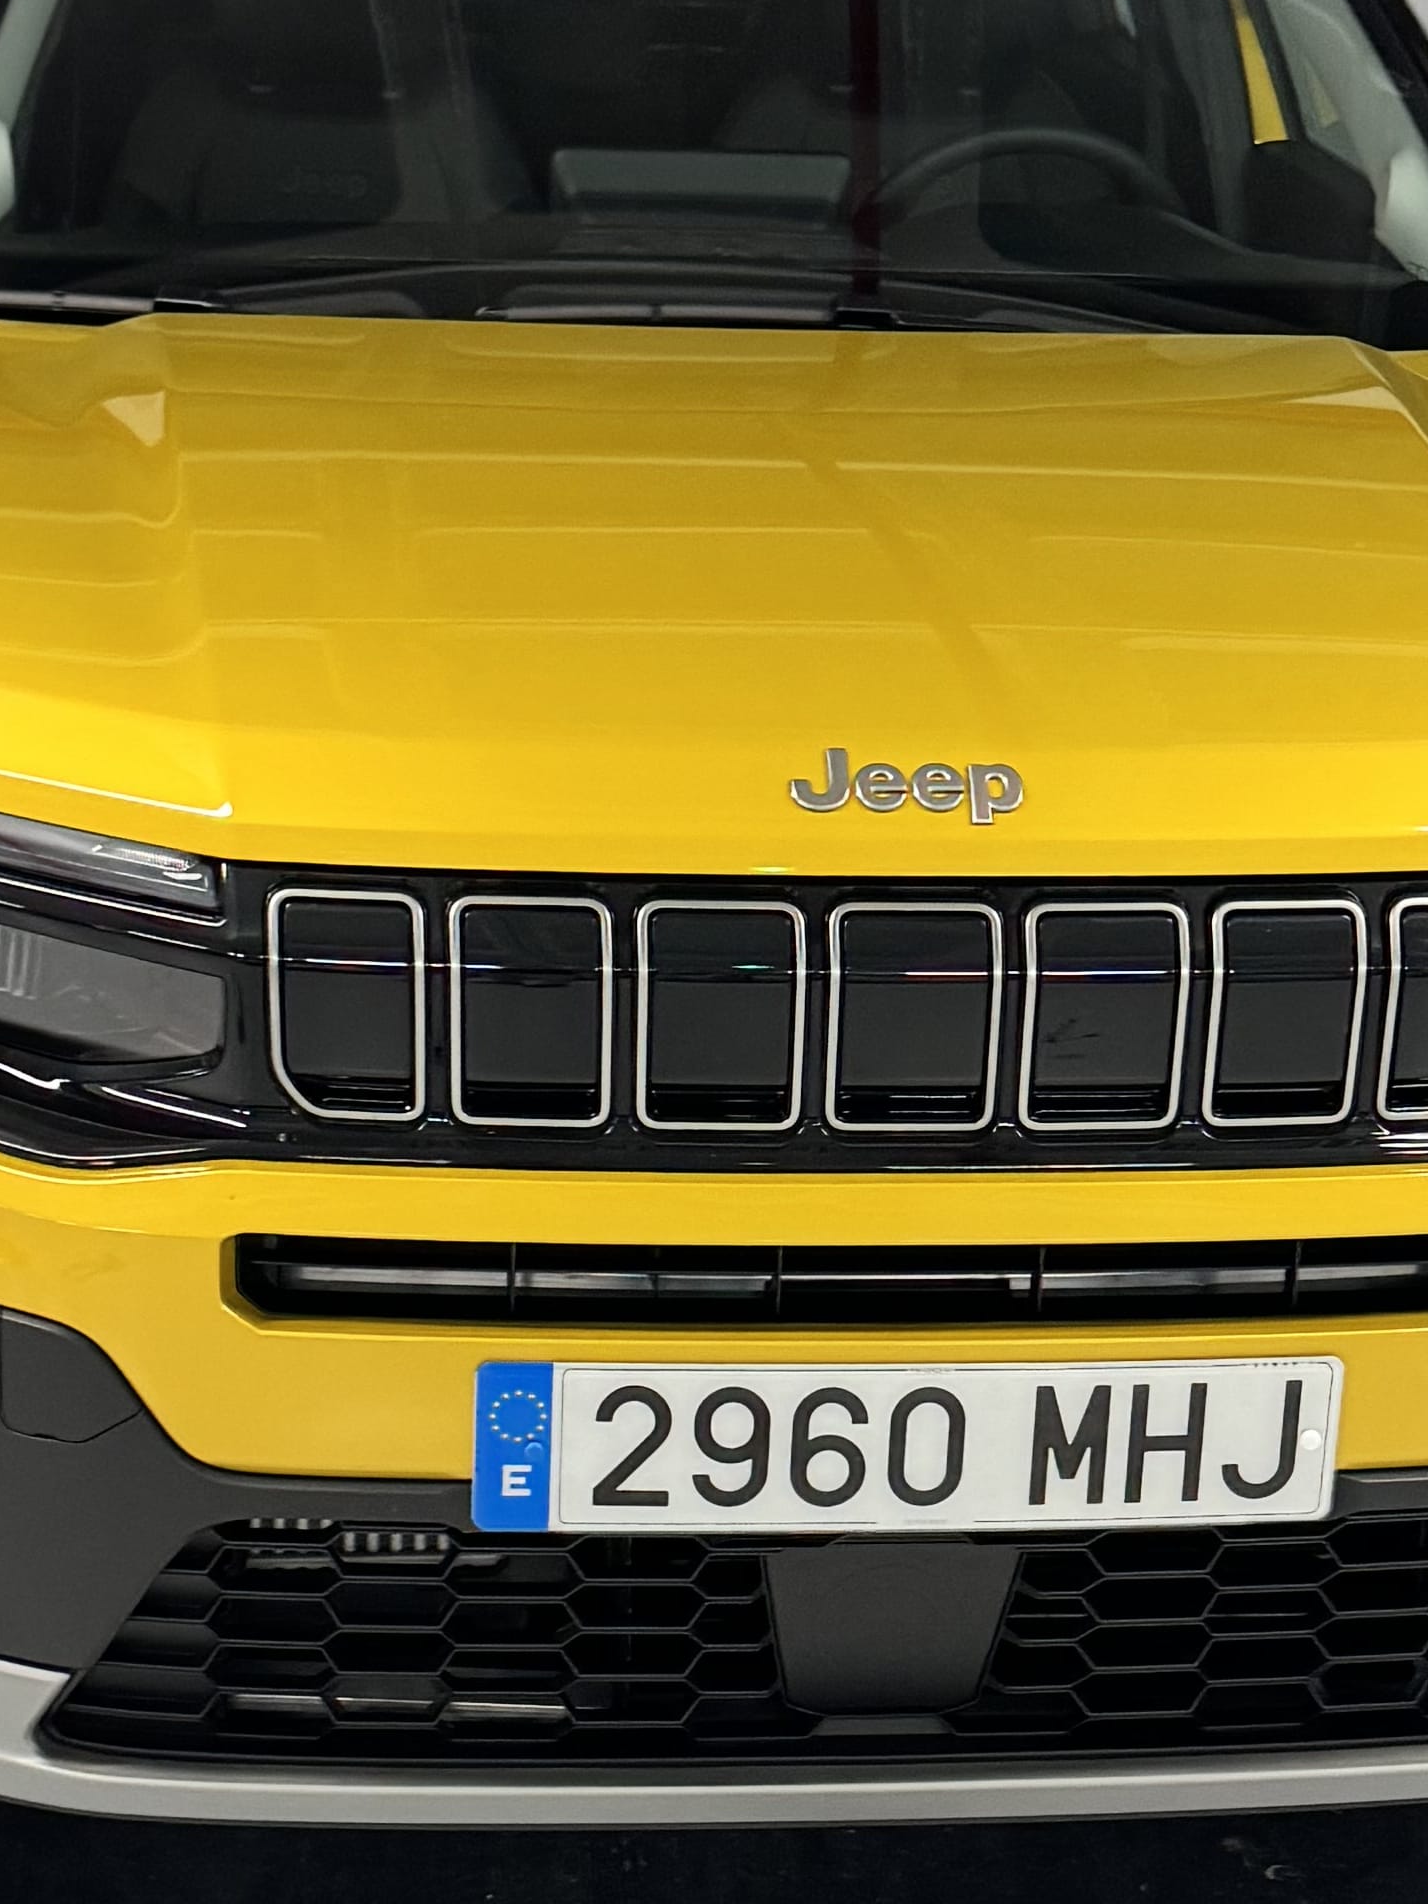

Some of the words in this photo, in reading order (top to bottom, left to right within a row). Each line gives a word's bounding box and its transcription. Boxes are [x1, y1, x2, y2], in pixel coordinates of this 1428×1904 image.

[790, 747, 1024, 826] Jeep
[501, 1464, 533, 1497] E
[592, 1385, 967, 1509] 2960
[1028, 1378, 1304, 1507] MHJ
